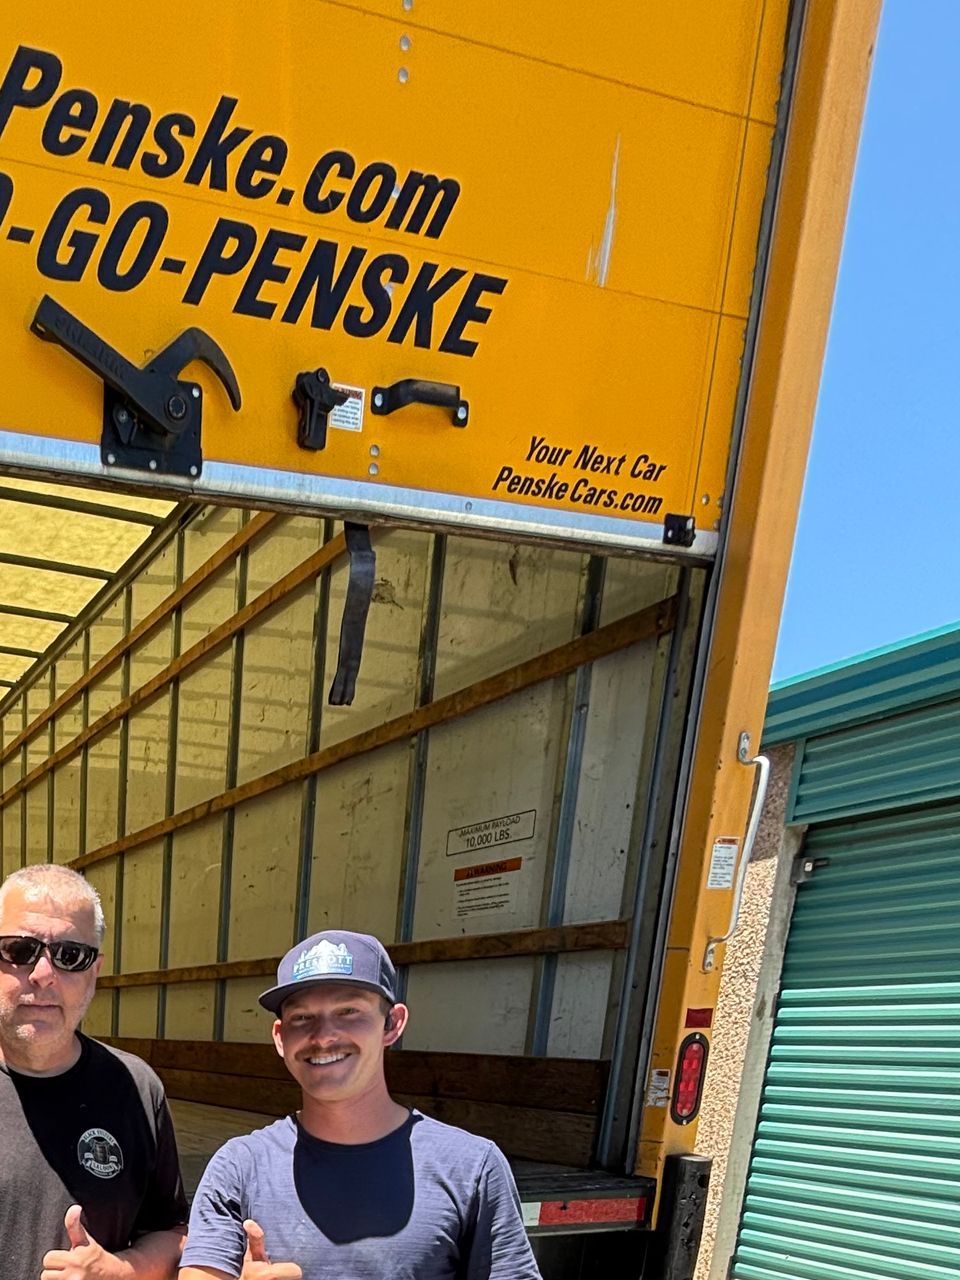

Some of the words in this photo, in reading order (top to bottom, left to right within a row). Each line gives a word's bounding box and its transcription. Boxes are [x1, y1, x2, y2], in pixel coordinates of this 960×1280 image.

[525, 435, 572, 467] Your
[573, 444, 626, 476] Next
[630, 453, 667, 482] Car
[459, 823, 491, 837] MAXIMUM
[491, 815, 521, 830] PAYLOAD
[466, 832, 492, 848] 10,000
[475, 862, 508, 878] WARNING
